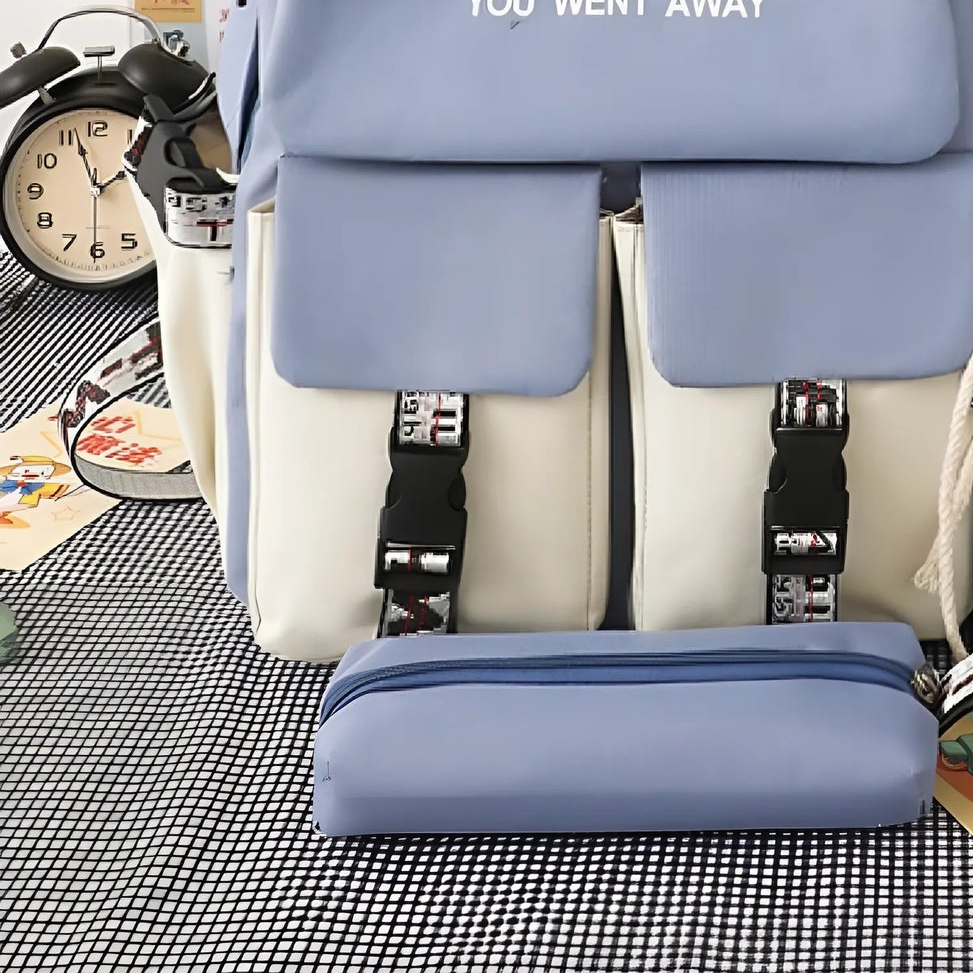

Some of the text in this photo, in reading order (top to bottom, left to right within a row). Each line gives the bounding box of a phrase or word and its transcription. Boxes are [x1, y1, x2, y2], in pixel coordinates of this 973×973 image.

[59, 129, 73, 146] 11
[87, 121, 108, 138] 12
[37, 152, 58, 169] 10
[27, 183, 44, 200] 9
[37, 212, 54, 229] 8
[62, 233, 77, 251] 7
[121, 233, 138, 251] 5
[90, 242, 105, 260] 6
